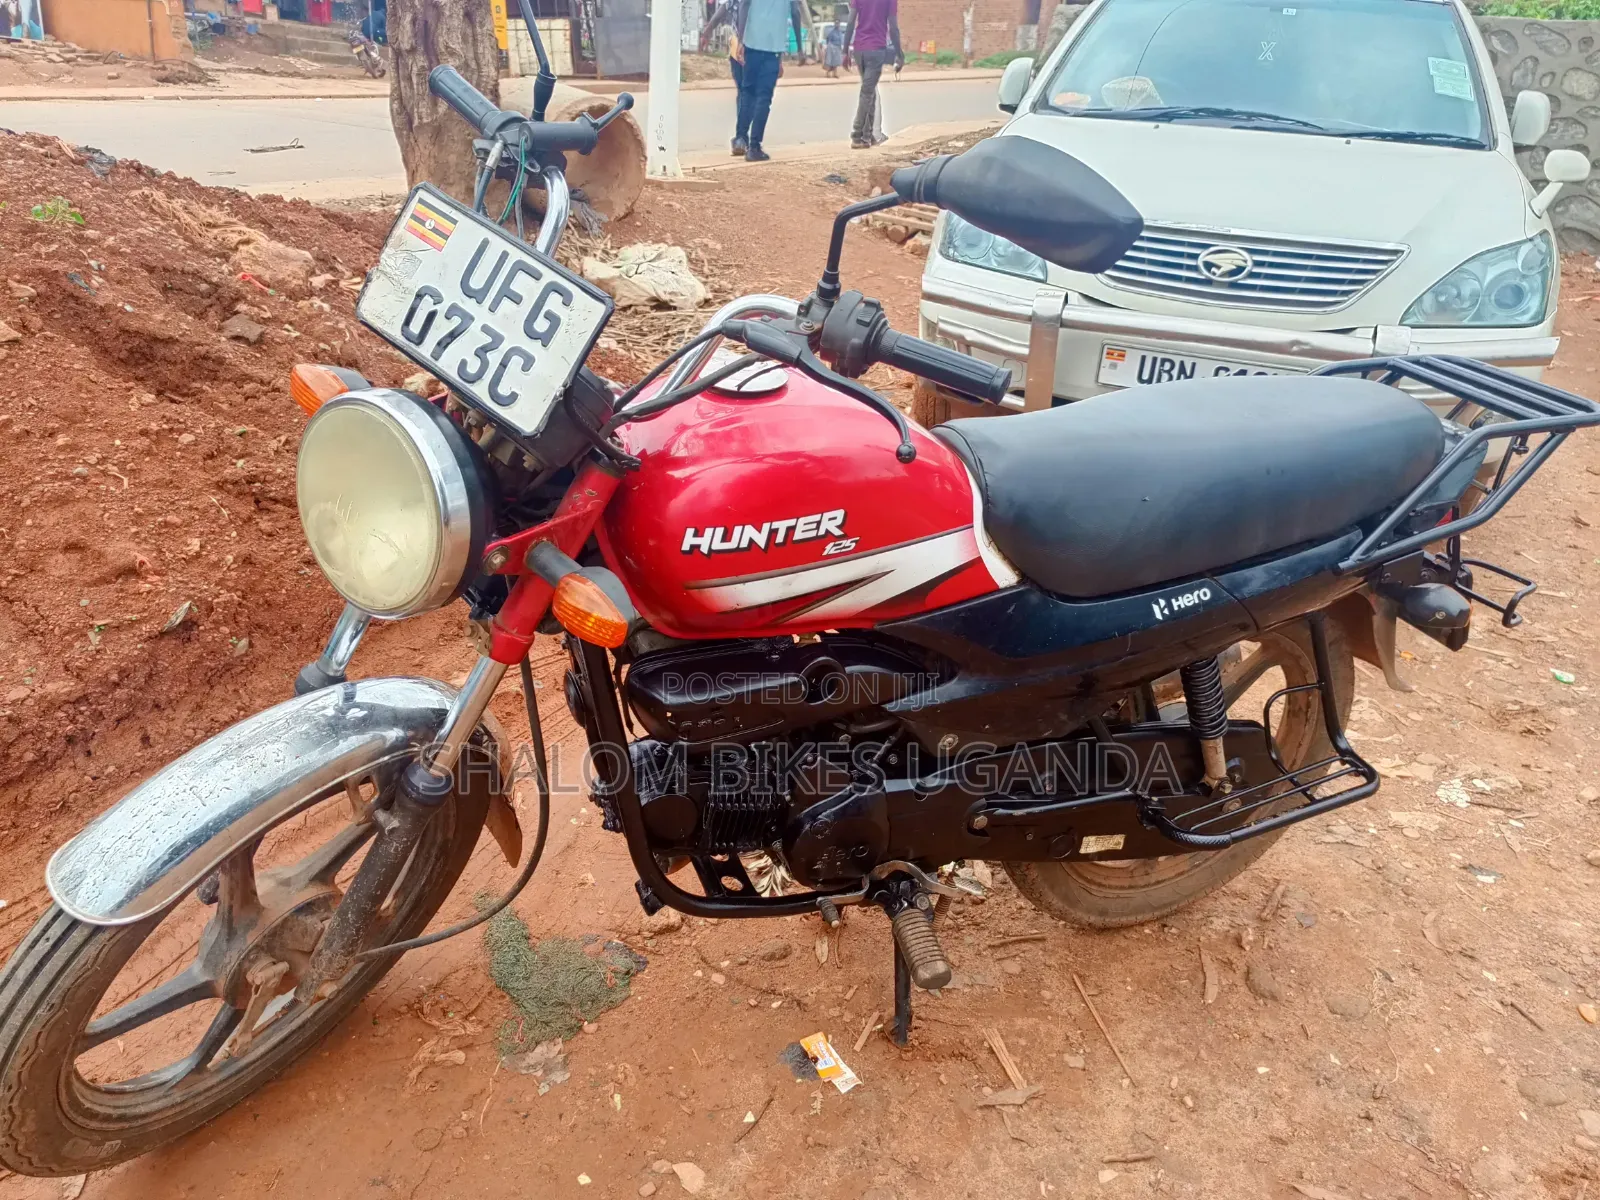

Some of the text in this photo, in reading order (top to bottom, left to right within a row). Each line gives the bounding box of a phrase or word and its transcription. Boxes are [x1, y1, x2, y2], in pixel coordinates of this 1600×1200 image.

[460, 237, 574, 347] UFG
[400, 285, 536, 407] 073C
[1136, 354, 1197, 386] UBN
[680, 508, 847, 557] HUNTER
[821, 537, 860, 556] 125
[1170, 587, 1211, 611] Hero
